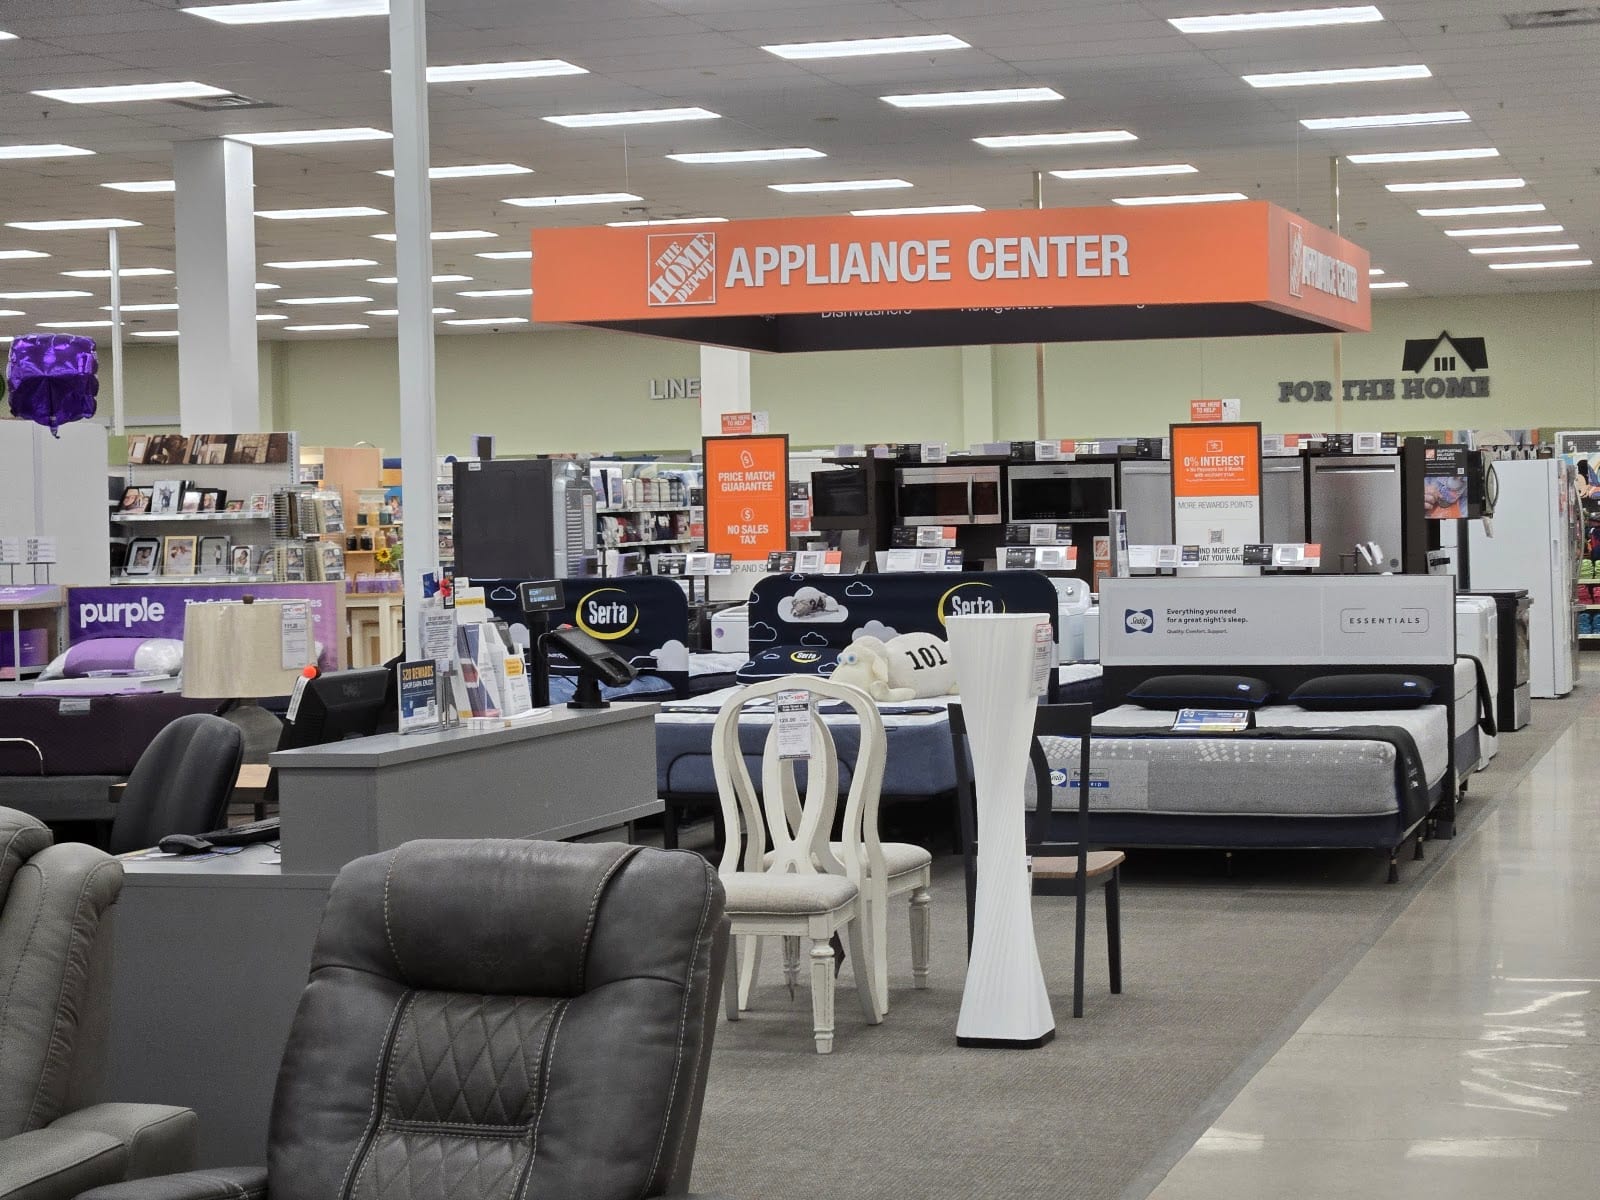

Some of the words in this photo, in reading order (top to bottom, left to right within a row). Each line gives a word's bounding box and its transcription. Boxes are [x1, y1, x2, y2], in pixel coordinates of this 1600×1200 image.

[655, 241, 682, 270] THE
[725, 239, 951, 288] APPLIANCE
[968, 234, 1130, 281] CENTER
[649, 234, 715, 304] HOME
[674, 258, 714, 303] DEPOT
[1278, 380, 1333, 403] FOR
[1342, 378, 1395, 401] THE
[1401, 376, 1490, 400] HOME
[1184, 456, 1199, 466] 0%
[1200, 455, 1246, 466] INTEREST
[718, 472, 743, 482] PRICE
[745, 471, 775, 481] MATCH
[721, 481, 773, 492] GUARANTEE
[1178, 501, 1197, 509] MORE
[1198, 501, 1228, 509] REWARDS
[1230, 500, 1254, 508] POINTS
[727, 525, 739, 535] NO
[741, 524, 769, 534] SALES
[739, 535, 757, 545] TAX
[741, 564, 757, 573] AND
[80, 596, 165, 629] purple
[588, 600, 628, 625] Serta
[951, 595, 994, 616] Serta
[1167, 608, 1204, 616] Everything
[796, 651, 817, 659] Serta
[905, 644, 948, 671] 101
